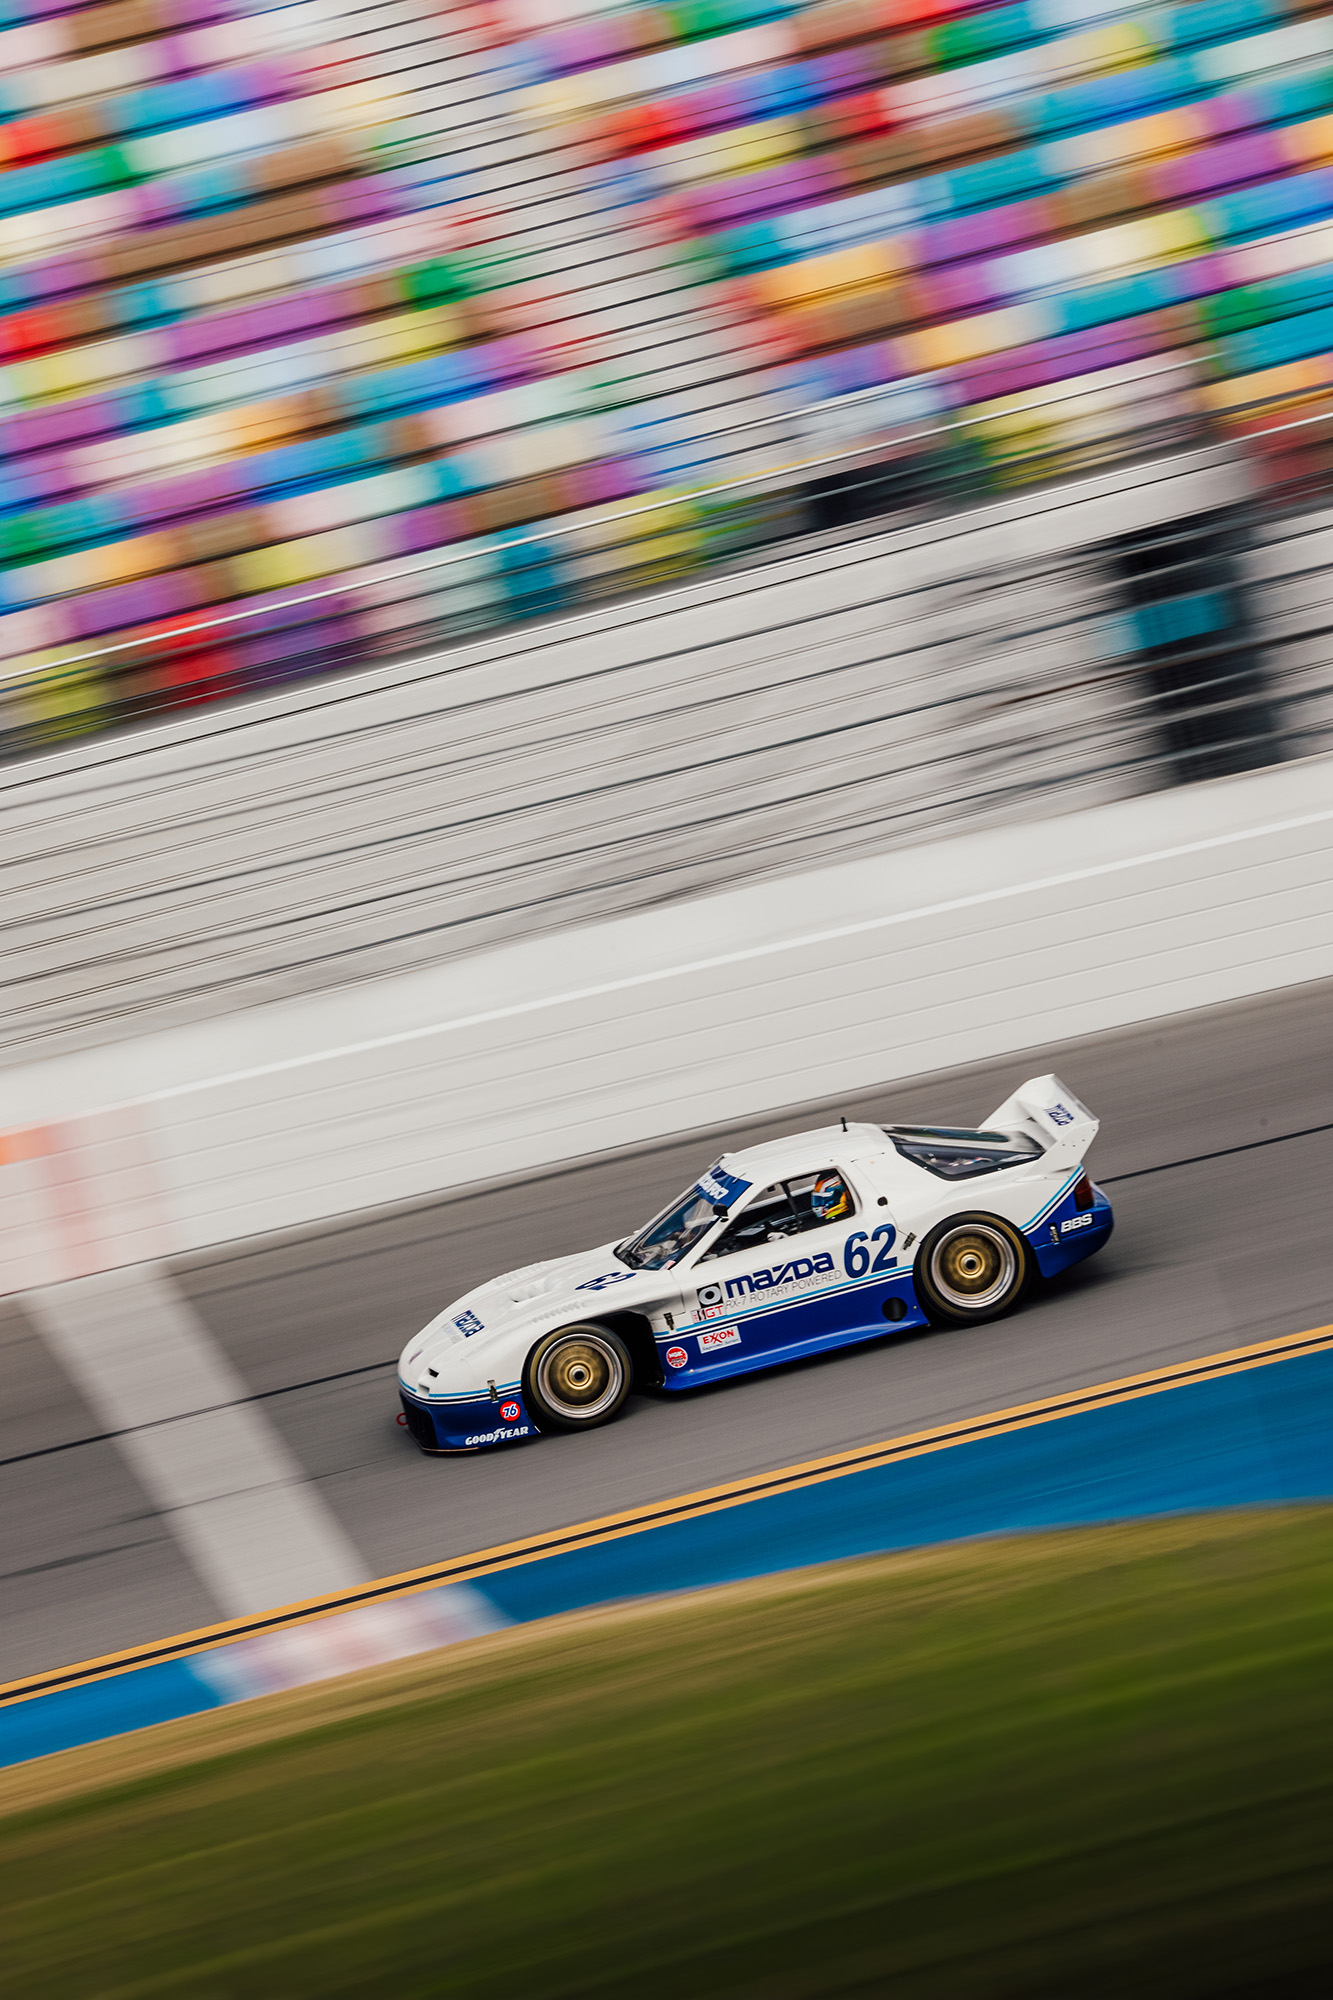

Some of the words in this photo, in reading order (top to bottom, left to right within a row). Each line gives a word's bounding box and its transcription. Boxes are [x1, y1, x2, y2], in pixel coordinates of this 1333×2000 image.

[1061, 1213, 1093, 1233] BBS
[844, 1223, 897, 1278] 62
[575, 1271, 637, 1291] 62
[750, 1285, 789, 1304] ROTARY
[792, 1270, 842, 1291] POWERED
[705, 1305, 724, 1319] GT
[702, 1329, 735, 1345] EXXON
[502, 1404, 518, 1418] 76
[465, 1426, 529, 1446] GOODYEAR
